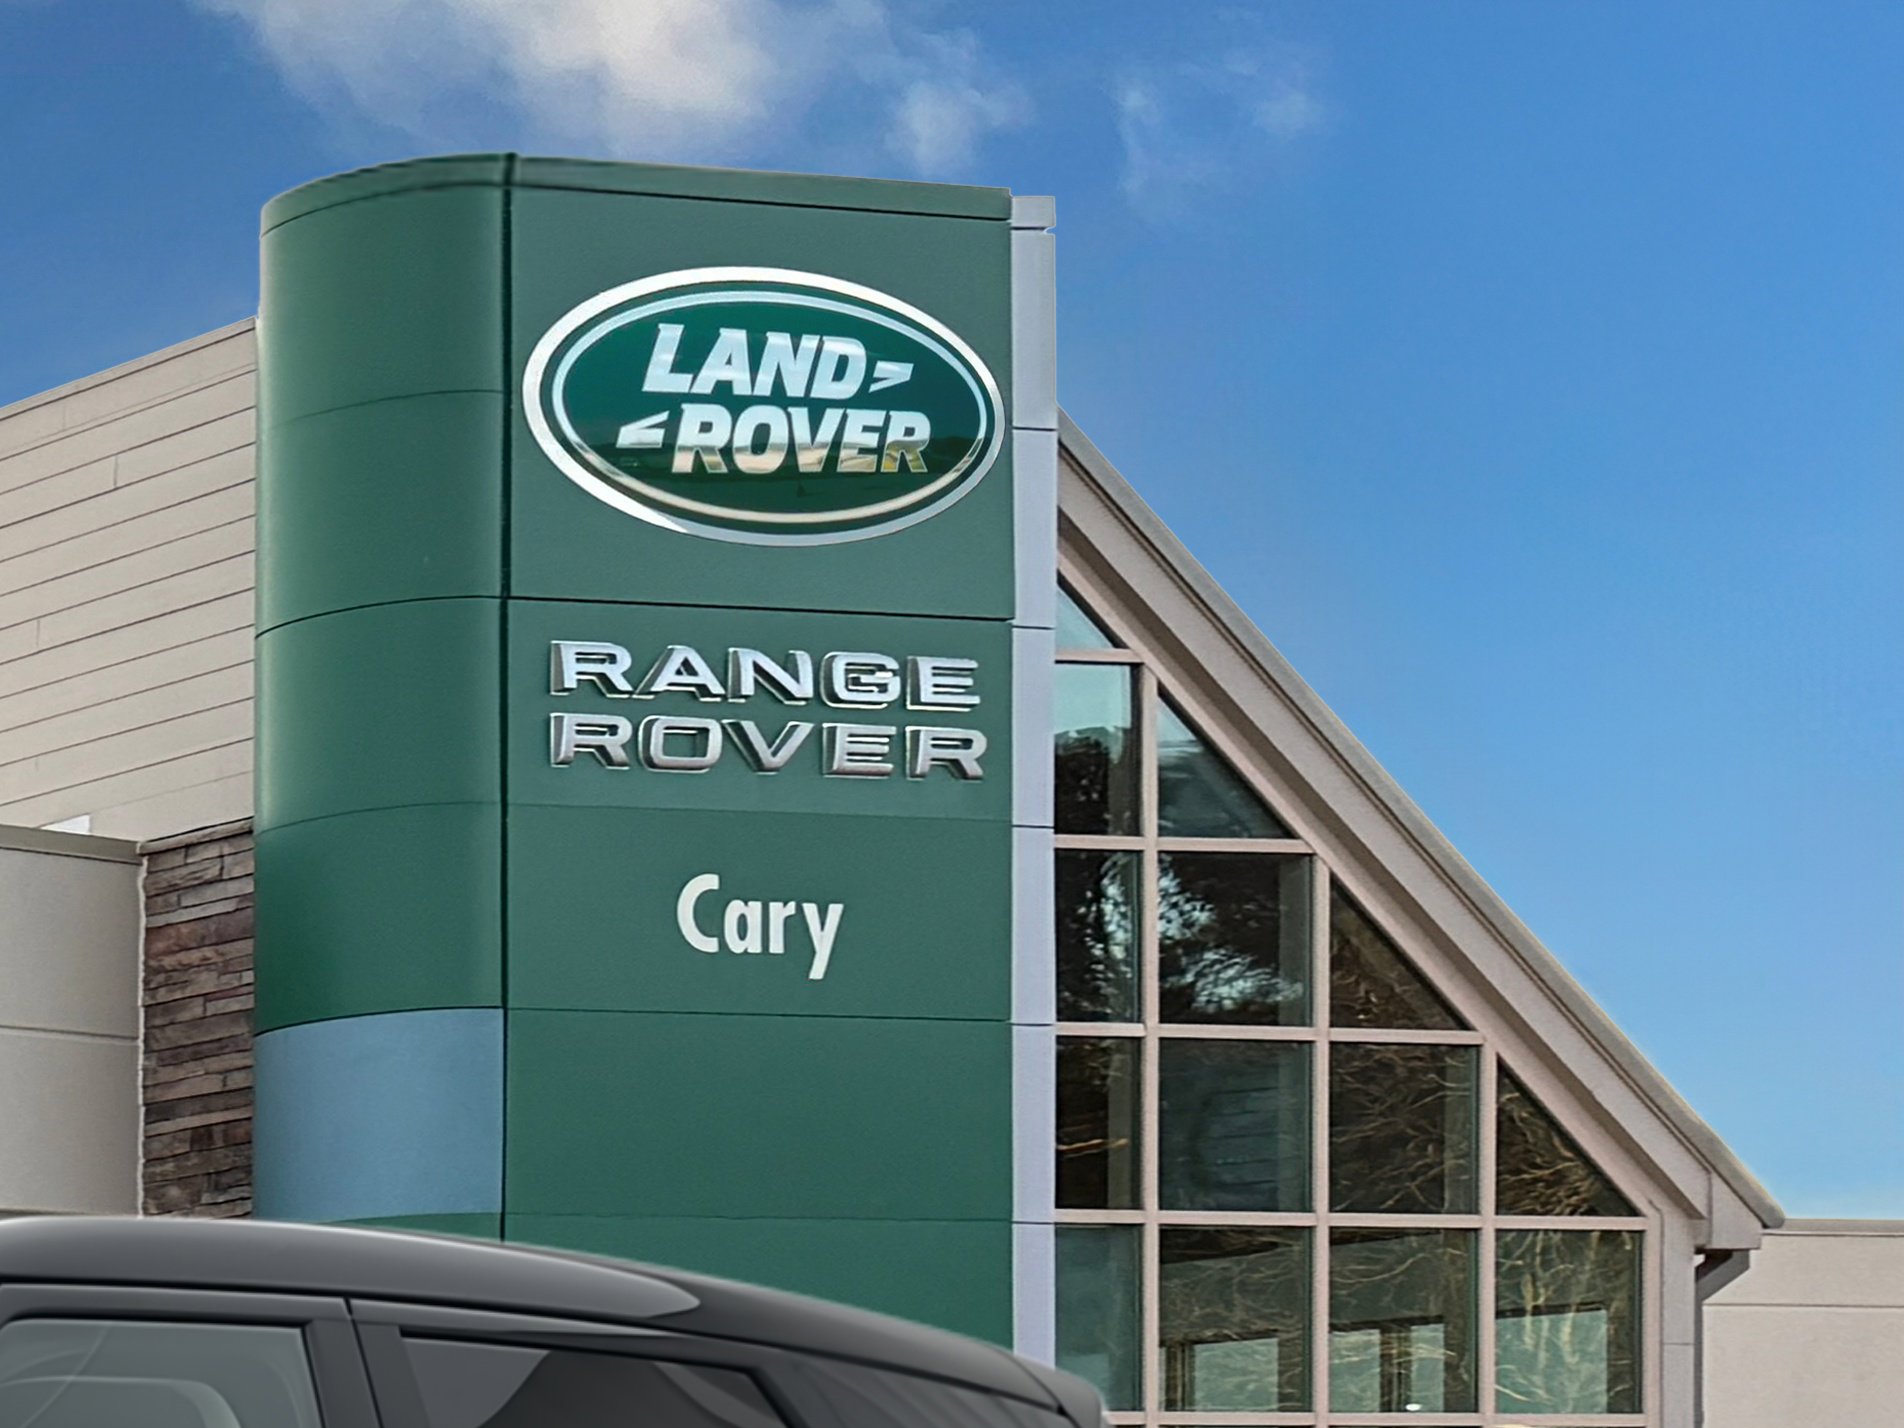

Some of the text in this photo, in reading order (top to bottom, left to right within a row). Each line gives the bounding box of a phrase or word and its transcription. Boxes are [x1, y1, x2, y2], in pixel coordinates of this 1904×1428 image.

[643, 323, 870, 399] LAND
[671, 404, 930, 474] ROVER
[550, 640, 982, 711] RANGE
[549, 712, 988, 780] ROVER
[676, 873, 845, 980] Cary
